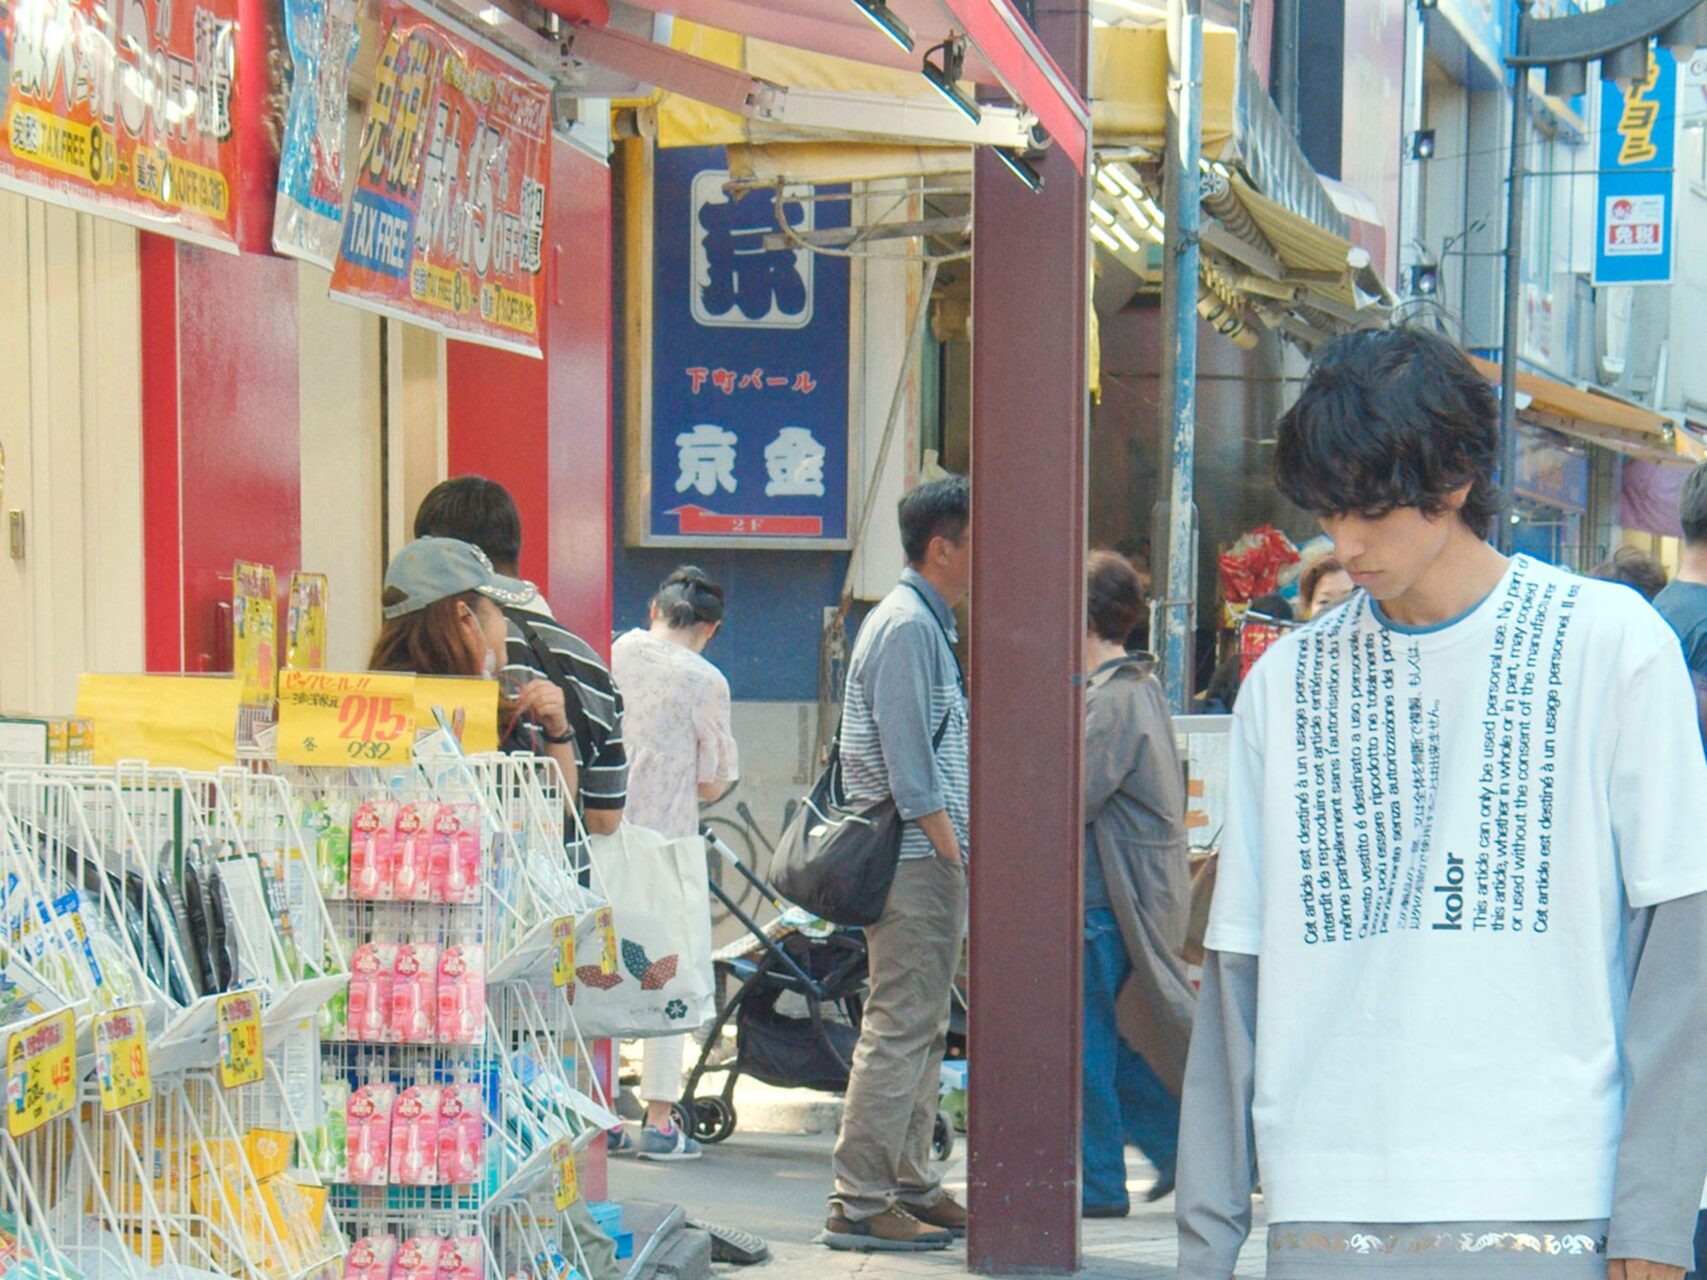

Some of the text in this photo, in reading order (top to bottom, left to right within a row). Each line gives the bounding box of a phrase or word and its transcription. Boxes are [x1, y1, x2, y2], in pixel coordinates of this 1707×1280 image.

[350, 202, 408, 269] TAX FREE
[685, 366, 818, 394] 下町バール
[732, 519, 764, 532] 2F
[1507, 571, 1525, 598] part
[1496, 601, 1514, 619] No
[1328, 640, 1339, 660] du
[1493, 623, 1508, 650] use.
[1364, 633, 1378, 708] totalmente
[1381, 669, 1394, 689] del
[1486, 654, 1502, 716] personal
[1521, 672, 1535, 696] the
[338, 694, 406, 742] 215
[1350, 702, 1361, 729] uso
[1367, 713, 1378, 731] ne
[1518, 699, 1532, 716] of
[1544, 689, 1561, 735] usage
[1295, 708, 1308, 751] usage
[1310, 716, 1323, 759] article
[1351, 733, 1361, 742] a
[1482, 721, 1496, 758] used
[347, 741, 391, 760] 232
[1382, 695, 1400, 796] autorizzazione
[1491, 582, 1538, 931] this article, whether in whole or in part, may copied
[1517, 721, 1531, 781] consent
[1543, 739, 1555, 758] un
[1297, 756, 1307, 775] un
[1313, 763, 1325, 785] cet
[1329, 758, 1341, 794] sans
[1349, 746, 1367, 816] destinato
[1366, 737, 1385, 806] ripodotto
[1479, 763, 1493, 783] be
[1540, 763, 1555, 772] à
[1294, 780, 1308, 788] à
[1514, 785, 1528, 808] the
[1478, 786, 1495, 817] only
[1538, 776, 1554, 830] destiné
[1295, 793, 1310, 844] destiné
[1314, 790, 1330, 866] reproduire
[1353, 820, 1368, 830] é
[1391, 800, 1402, 842] senza
[1331, 799, 1352, 891] partiellement
[1373, 811, 1387, 858] essere
[1480, 822, 1491, 848] can
[1512, 813, 1527, 870] without
[1538, 834, 1551, 857] est
[1299, 849, 1311, 870] est
[1356, 833, 1372, 882] vestito
[1317, 871, 1331, 889] de
[1474, 852, 1489, 895] article
[1535, 861, 1550, 905] article
[1300, 875, 1316, 917] article
[1432, 852, 1464, 930] kolor
[1511, 875, 1525, 911] used
[1319, 893, 1336, 943] interdit
[1339, 894, 1352, 941] même
[1472, 900, 1487, 931] This
[1512, 916, 1522, 932] or
[1532, 909, 1549, 933] Cet
[1304, 922, 1318, 944] Cet
